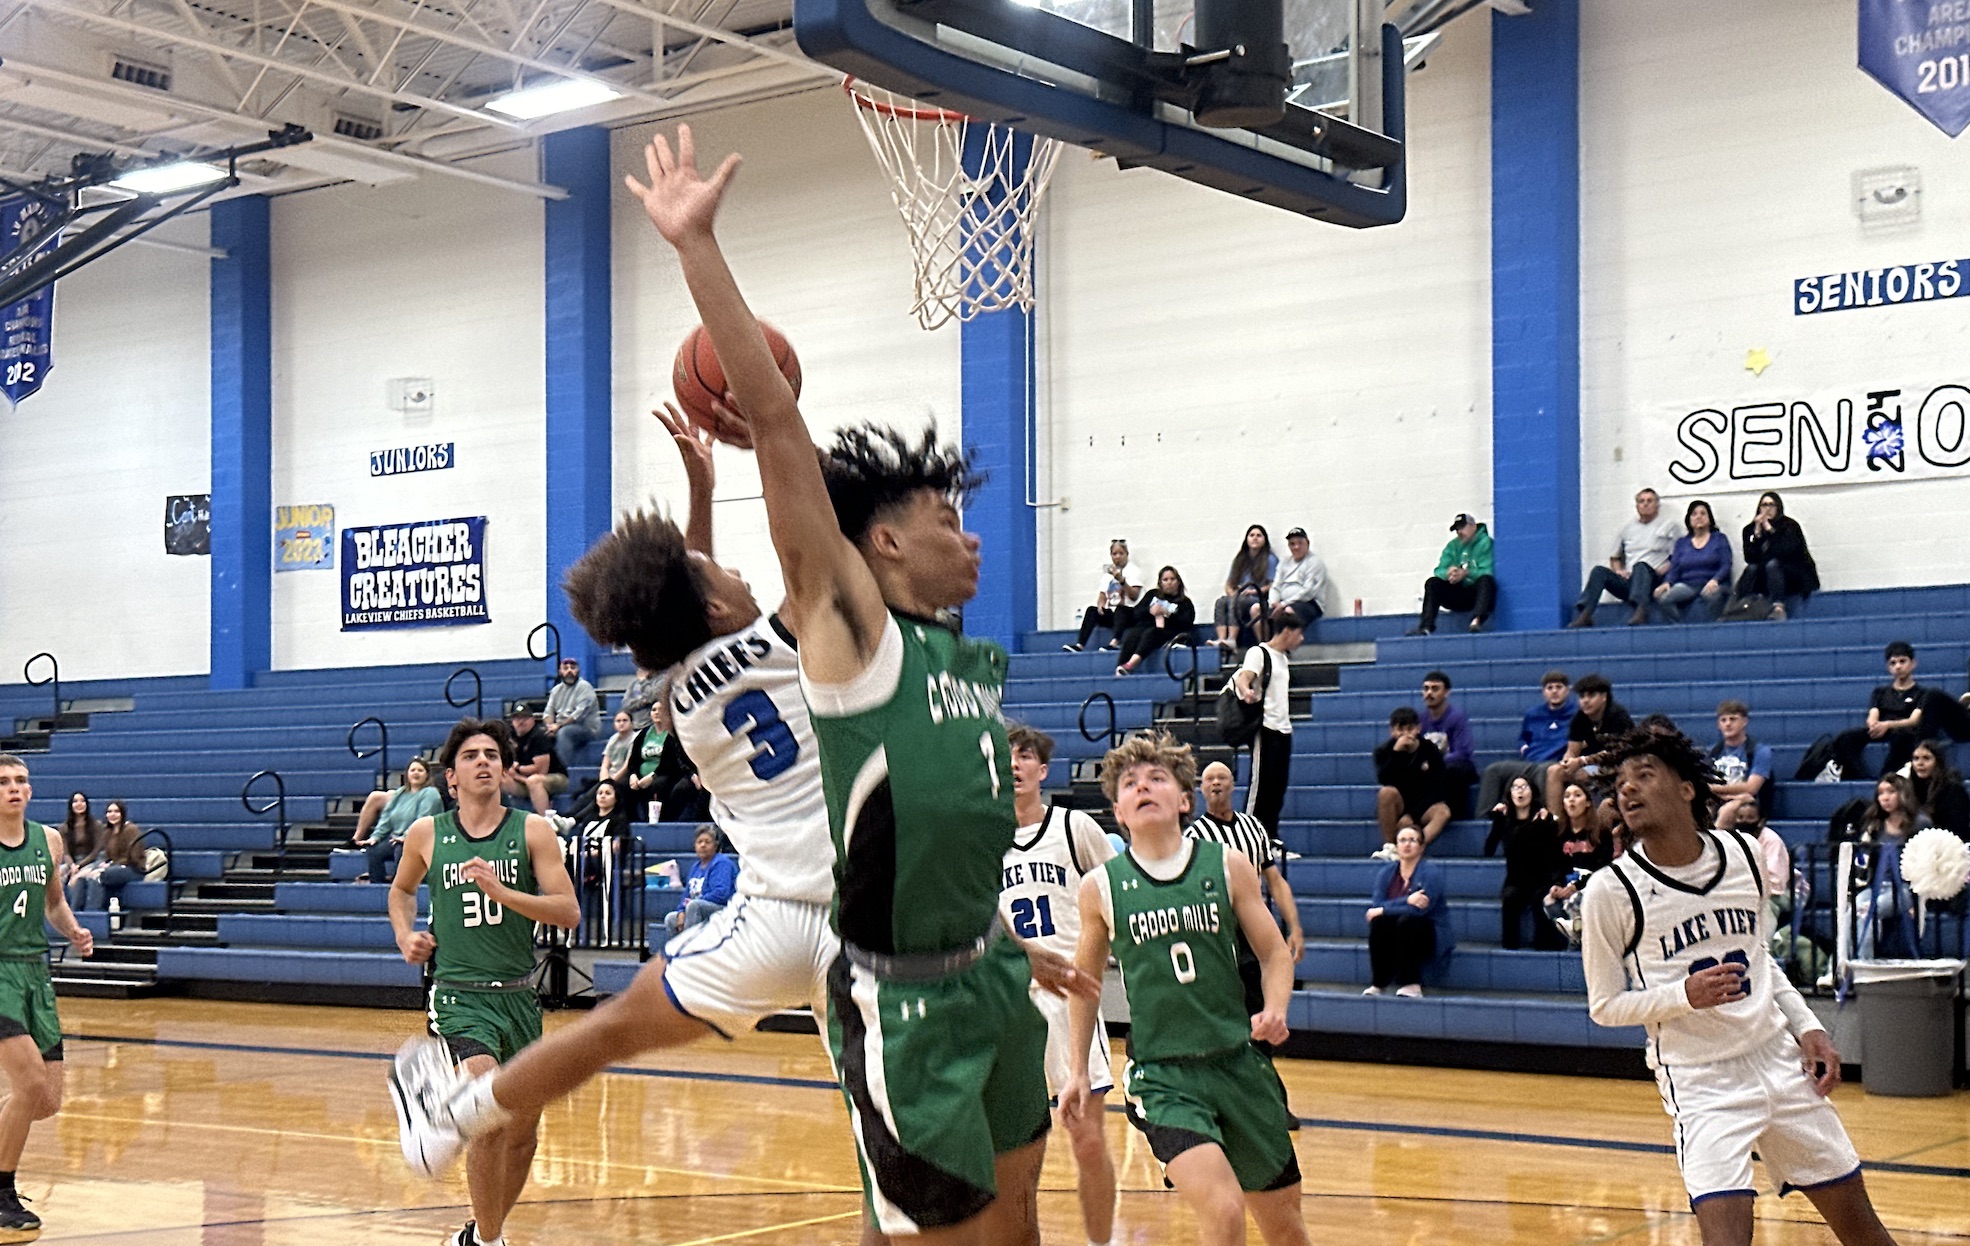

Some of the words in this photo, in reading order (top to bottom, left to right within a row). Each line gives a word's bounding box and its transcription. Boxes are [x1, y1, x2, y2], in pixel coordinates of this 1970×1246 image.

[1928, 1, 1970, 28] ARE
[1799, 260, 1961, 313] SENIORS
[371, 443, 449, 475] JUNIORS
[276, 504, 333, 530] JUNIOR
[354, 522, 472, 569] BLEACHER
[350, 563, 481, 610] CREATURES
[345, 610, 393, 624] LAKEVIEW
[393, 609, 424, 621] CHIEFS
[425, 605, 486, 619] BASKETBALL
[674, 637, 771, 714] CHIEFS
[723, 689, 800, 781] 3
[979, 730, 1001, 800] 1
[0, 865, 22, 887] DDO
[1028, 862, 1067, 888] VIEW
[13, 889, 28, 918] 4
[461, 891, 503, 928] 30
[1010, 894, 1056, 939] 21
[1128, 906, 1180, 946] CADDO
[1182, 901, 1220, 935] MILLS
[1659, 913, 1710, 961] LAKE
[1170, 941, 1196, 985] 0
